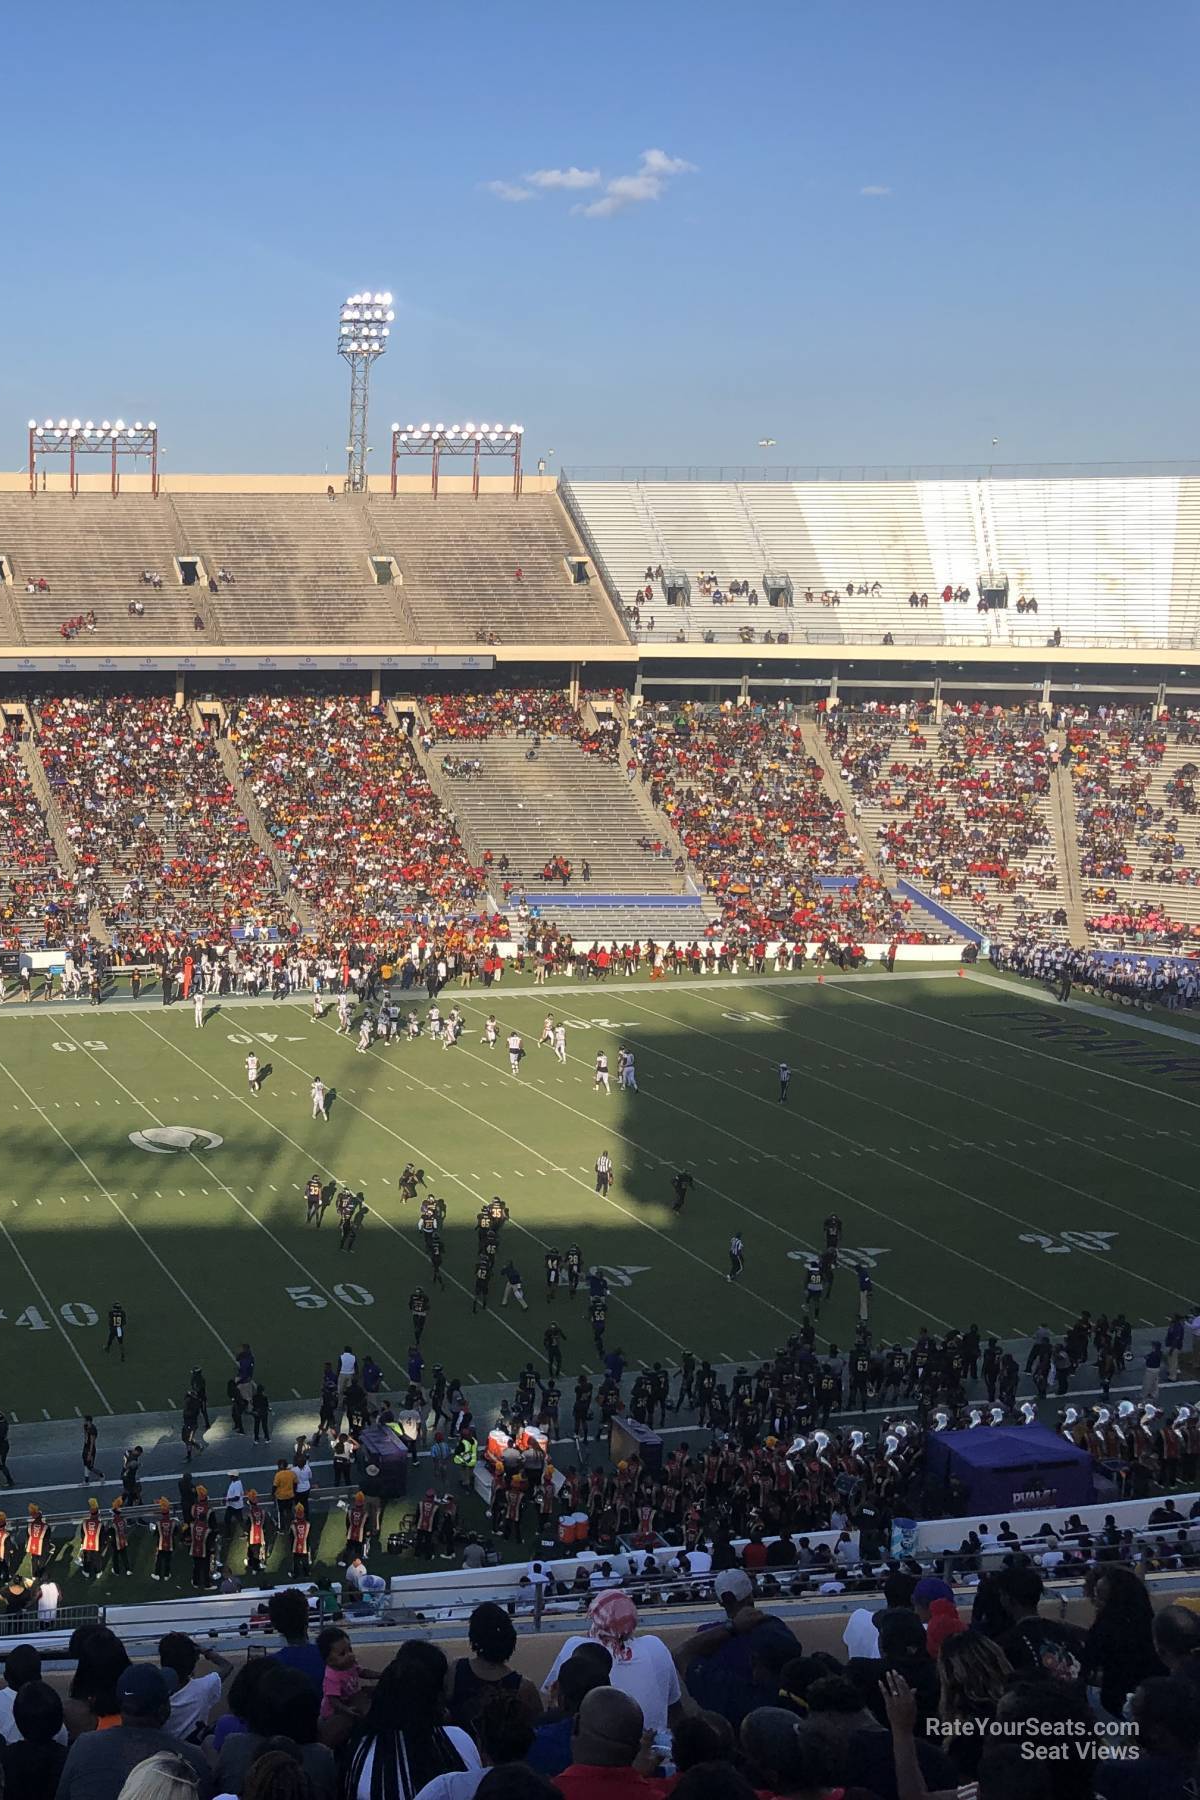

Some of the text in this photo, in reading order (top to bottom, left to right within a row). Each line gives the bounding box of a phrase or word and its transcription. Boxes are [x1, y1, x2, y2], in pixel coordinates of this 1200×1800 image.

[51, 1040, 109, 1052] 50
[285, 1283, 375, 1309] 50
[15, 1302, 99, 1330] 40
